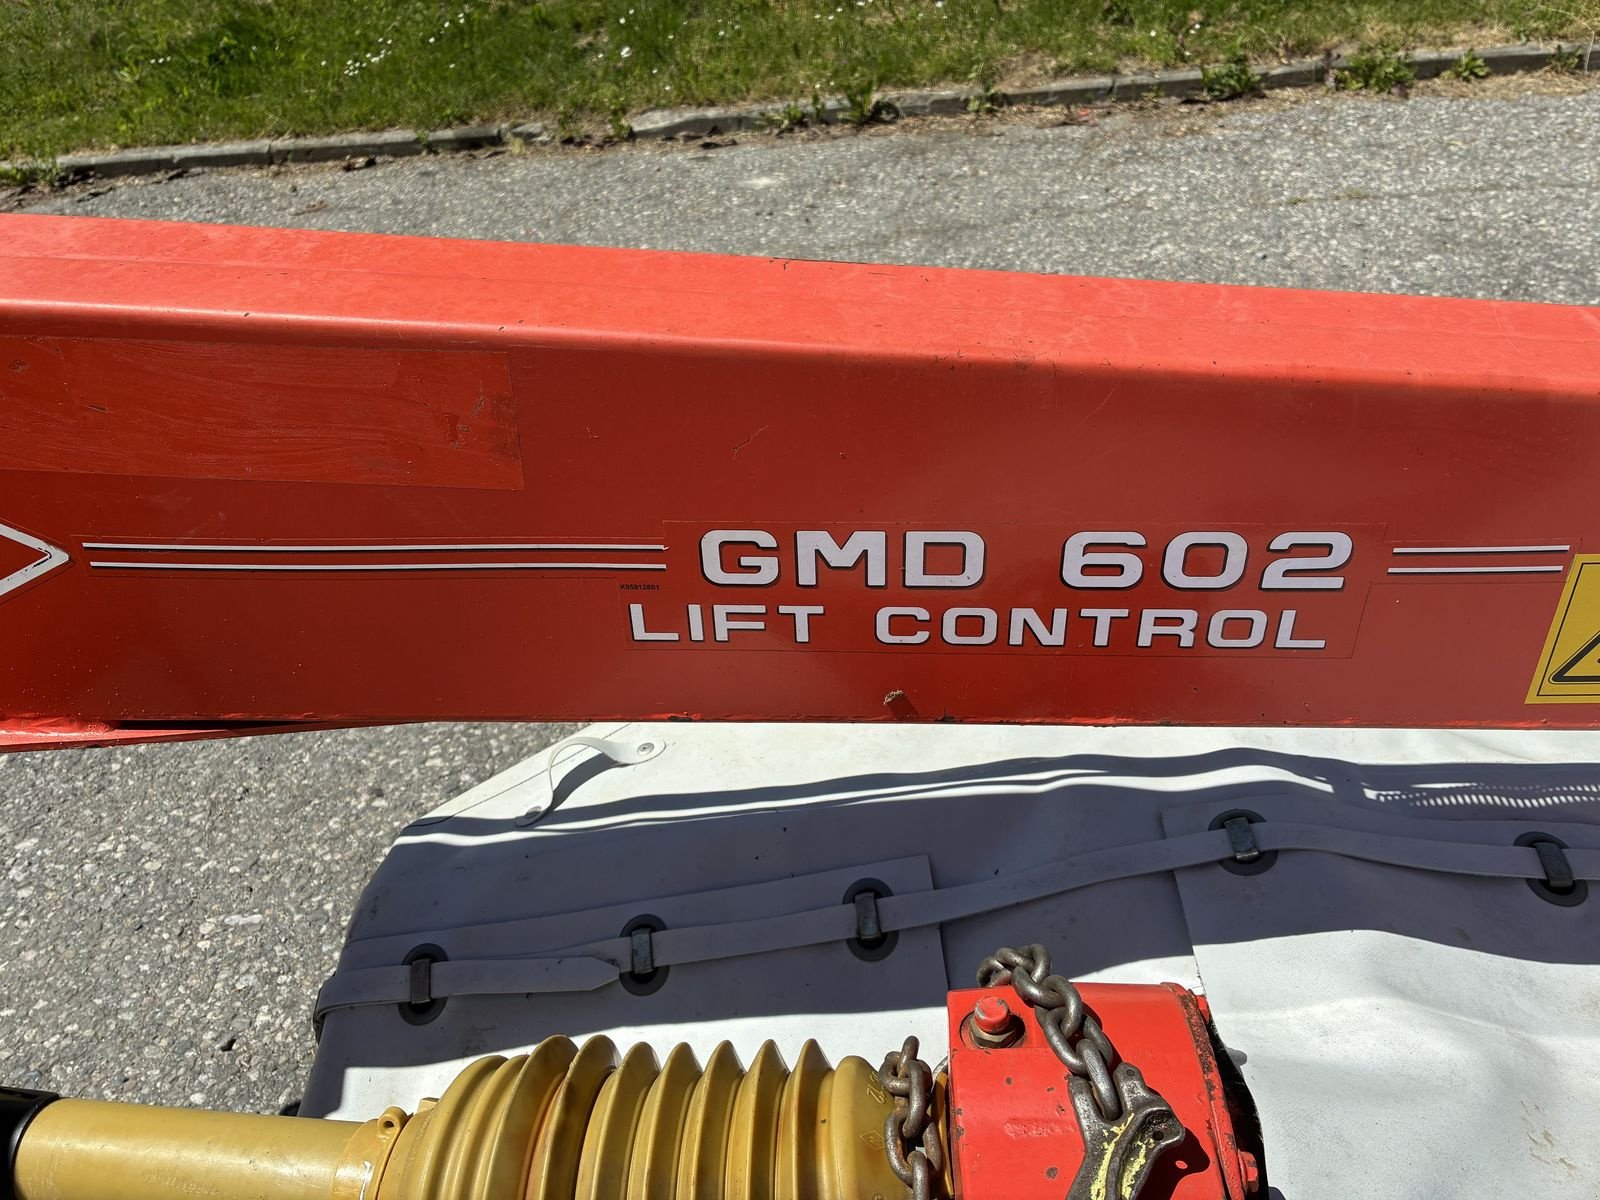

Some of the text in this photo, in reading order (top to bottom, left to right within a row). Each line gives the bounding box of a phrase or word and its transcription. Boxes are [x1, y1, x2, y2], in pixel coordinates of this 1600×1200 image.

[700, 530, 1354, 590] GMD 602
[629, 603, 1327, 649] LIFT CONTROL
